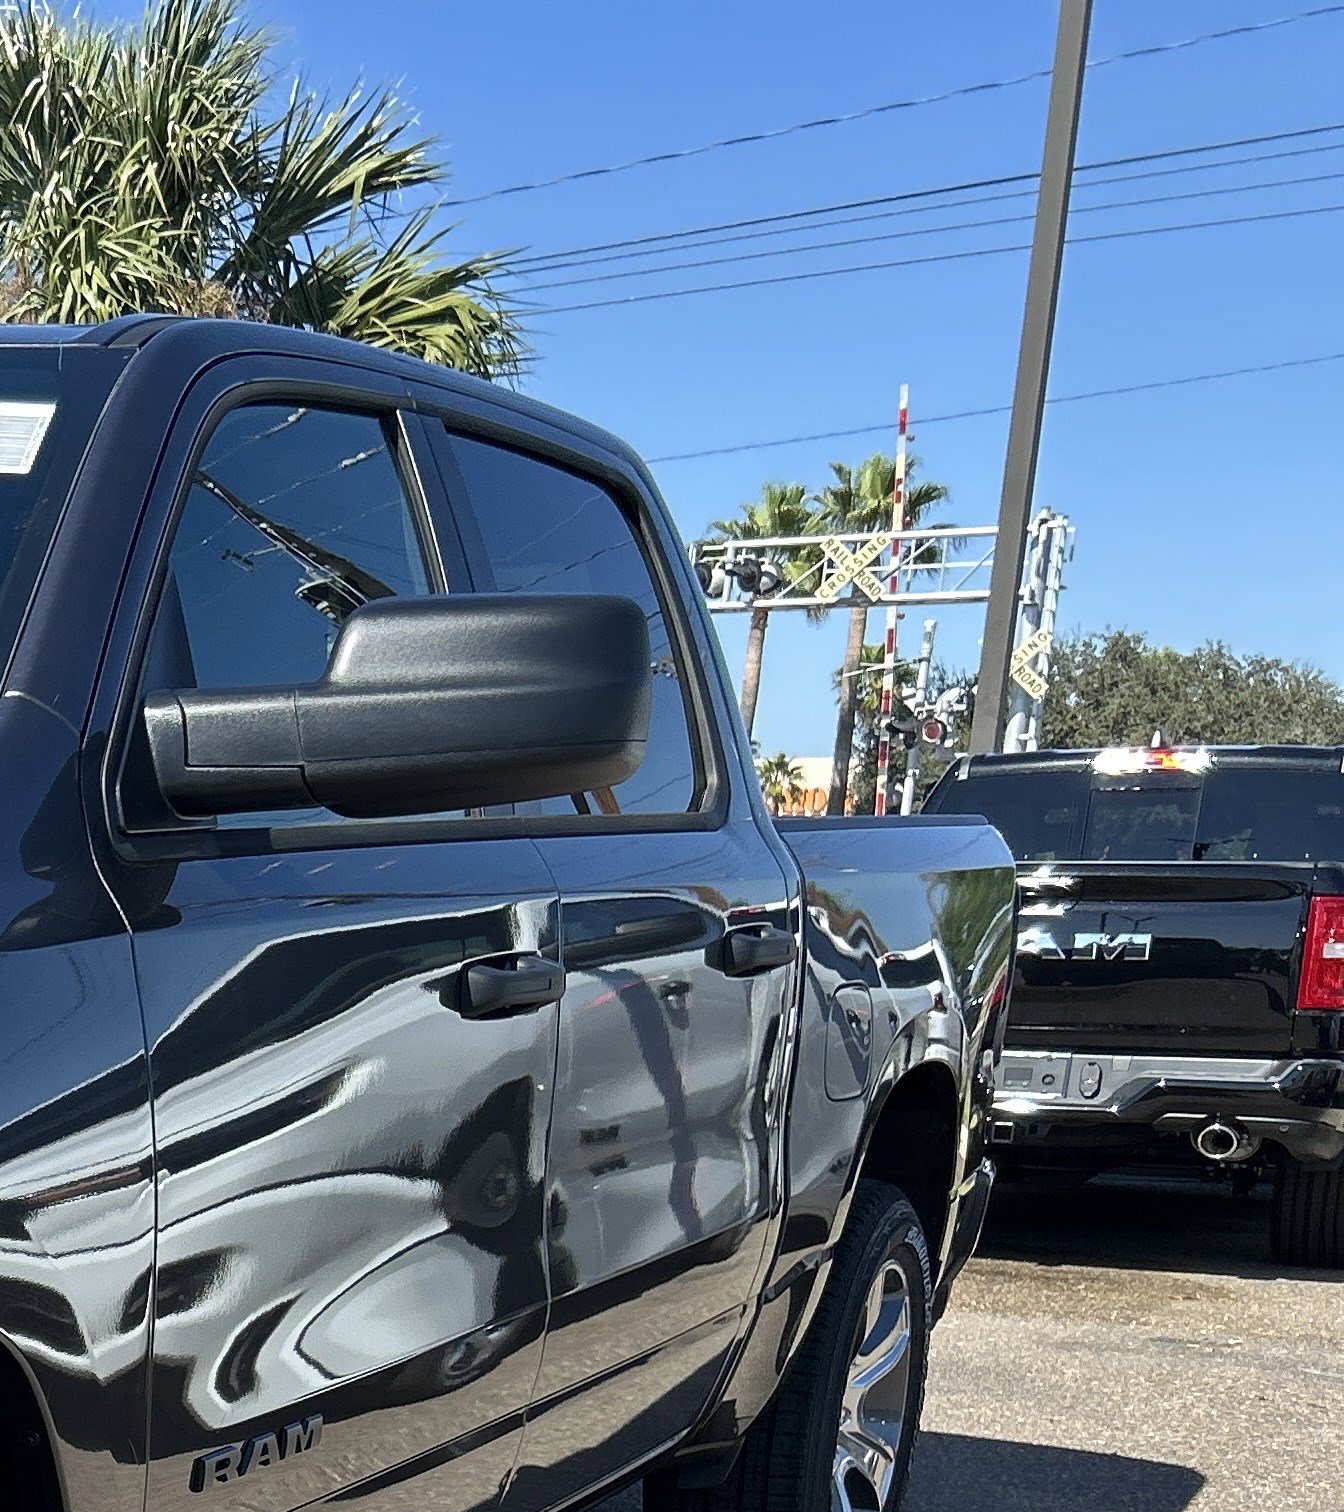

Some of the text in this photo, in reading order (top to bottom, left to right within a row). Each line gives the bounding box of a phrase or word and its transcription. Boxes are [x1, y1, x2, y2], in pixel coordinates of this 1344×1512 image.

[819, 535, 887, 599] CROSSING
[824, 538, 882, 597] RAIL ROAD
[1014, 665, 1042, 694] ROAD
[1016, 932, 1152, 961] AM
[189, 1413, 324, 1493] RAM
